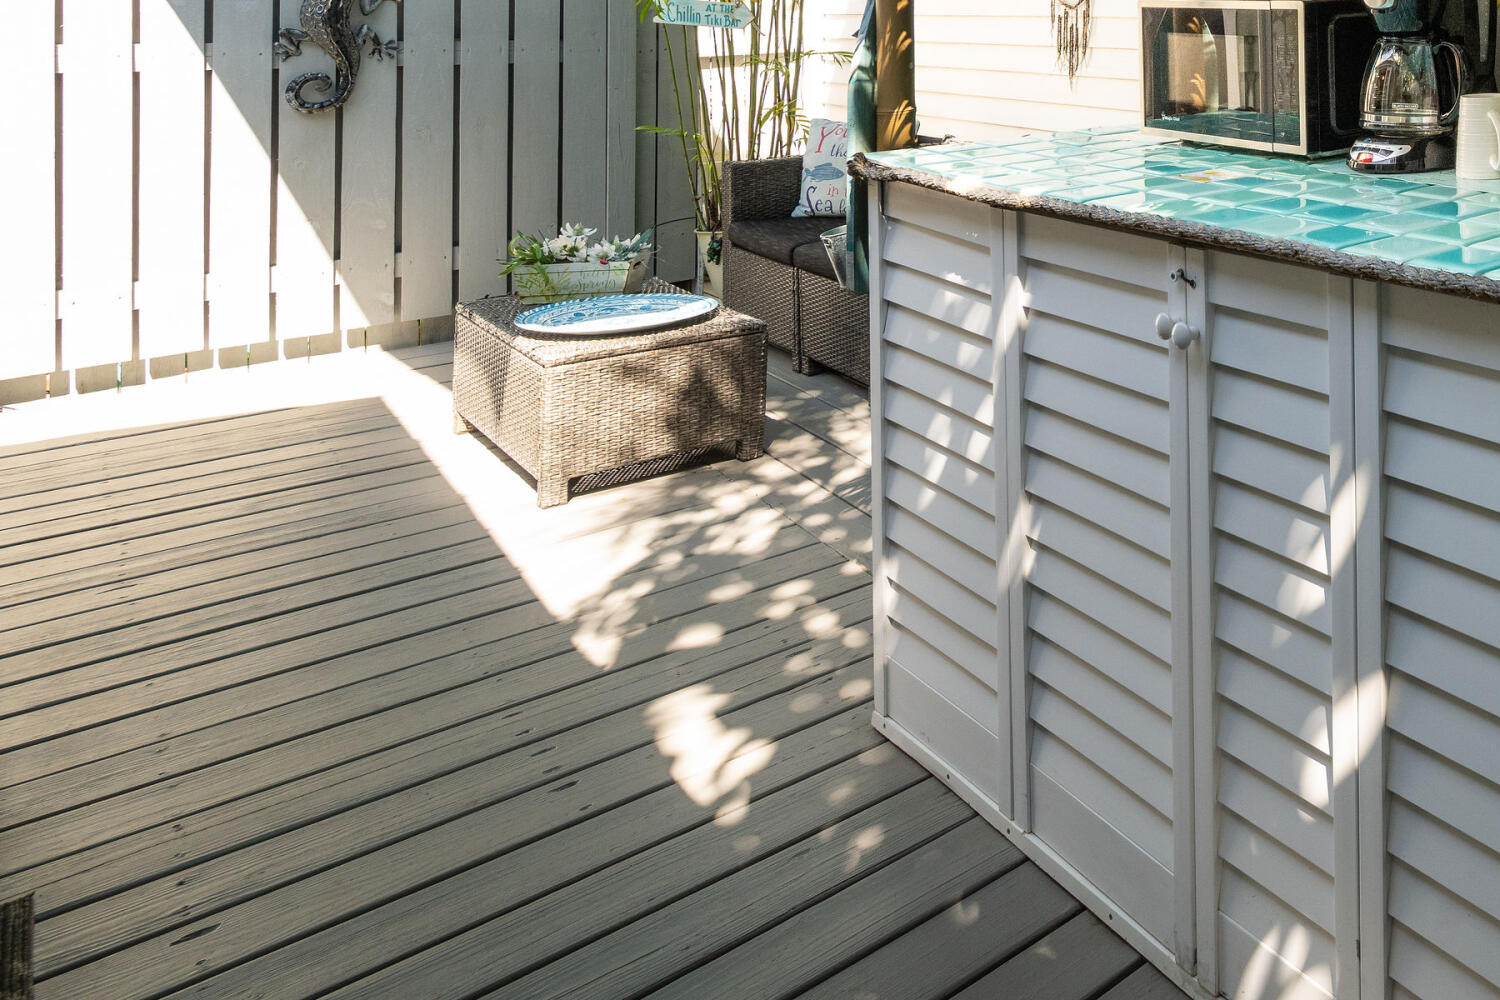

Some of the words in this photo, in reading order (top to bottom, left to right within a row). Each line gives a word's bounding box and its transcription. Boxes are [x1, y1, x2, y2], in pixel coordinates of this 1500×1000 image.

[667, 1, 700, 24] Chillin
[705, 4, 717, 13] AT
[720, 4, 734, 13] THE
[804, 185, 834, 217] Sea
[827, 184, 839, 197] in
